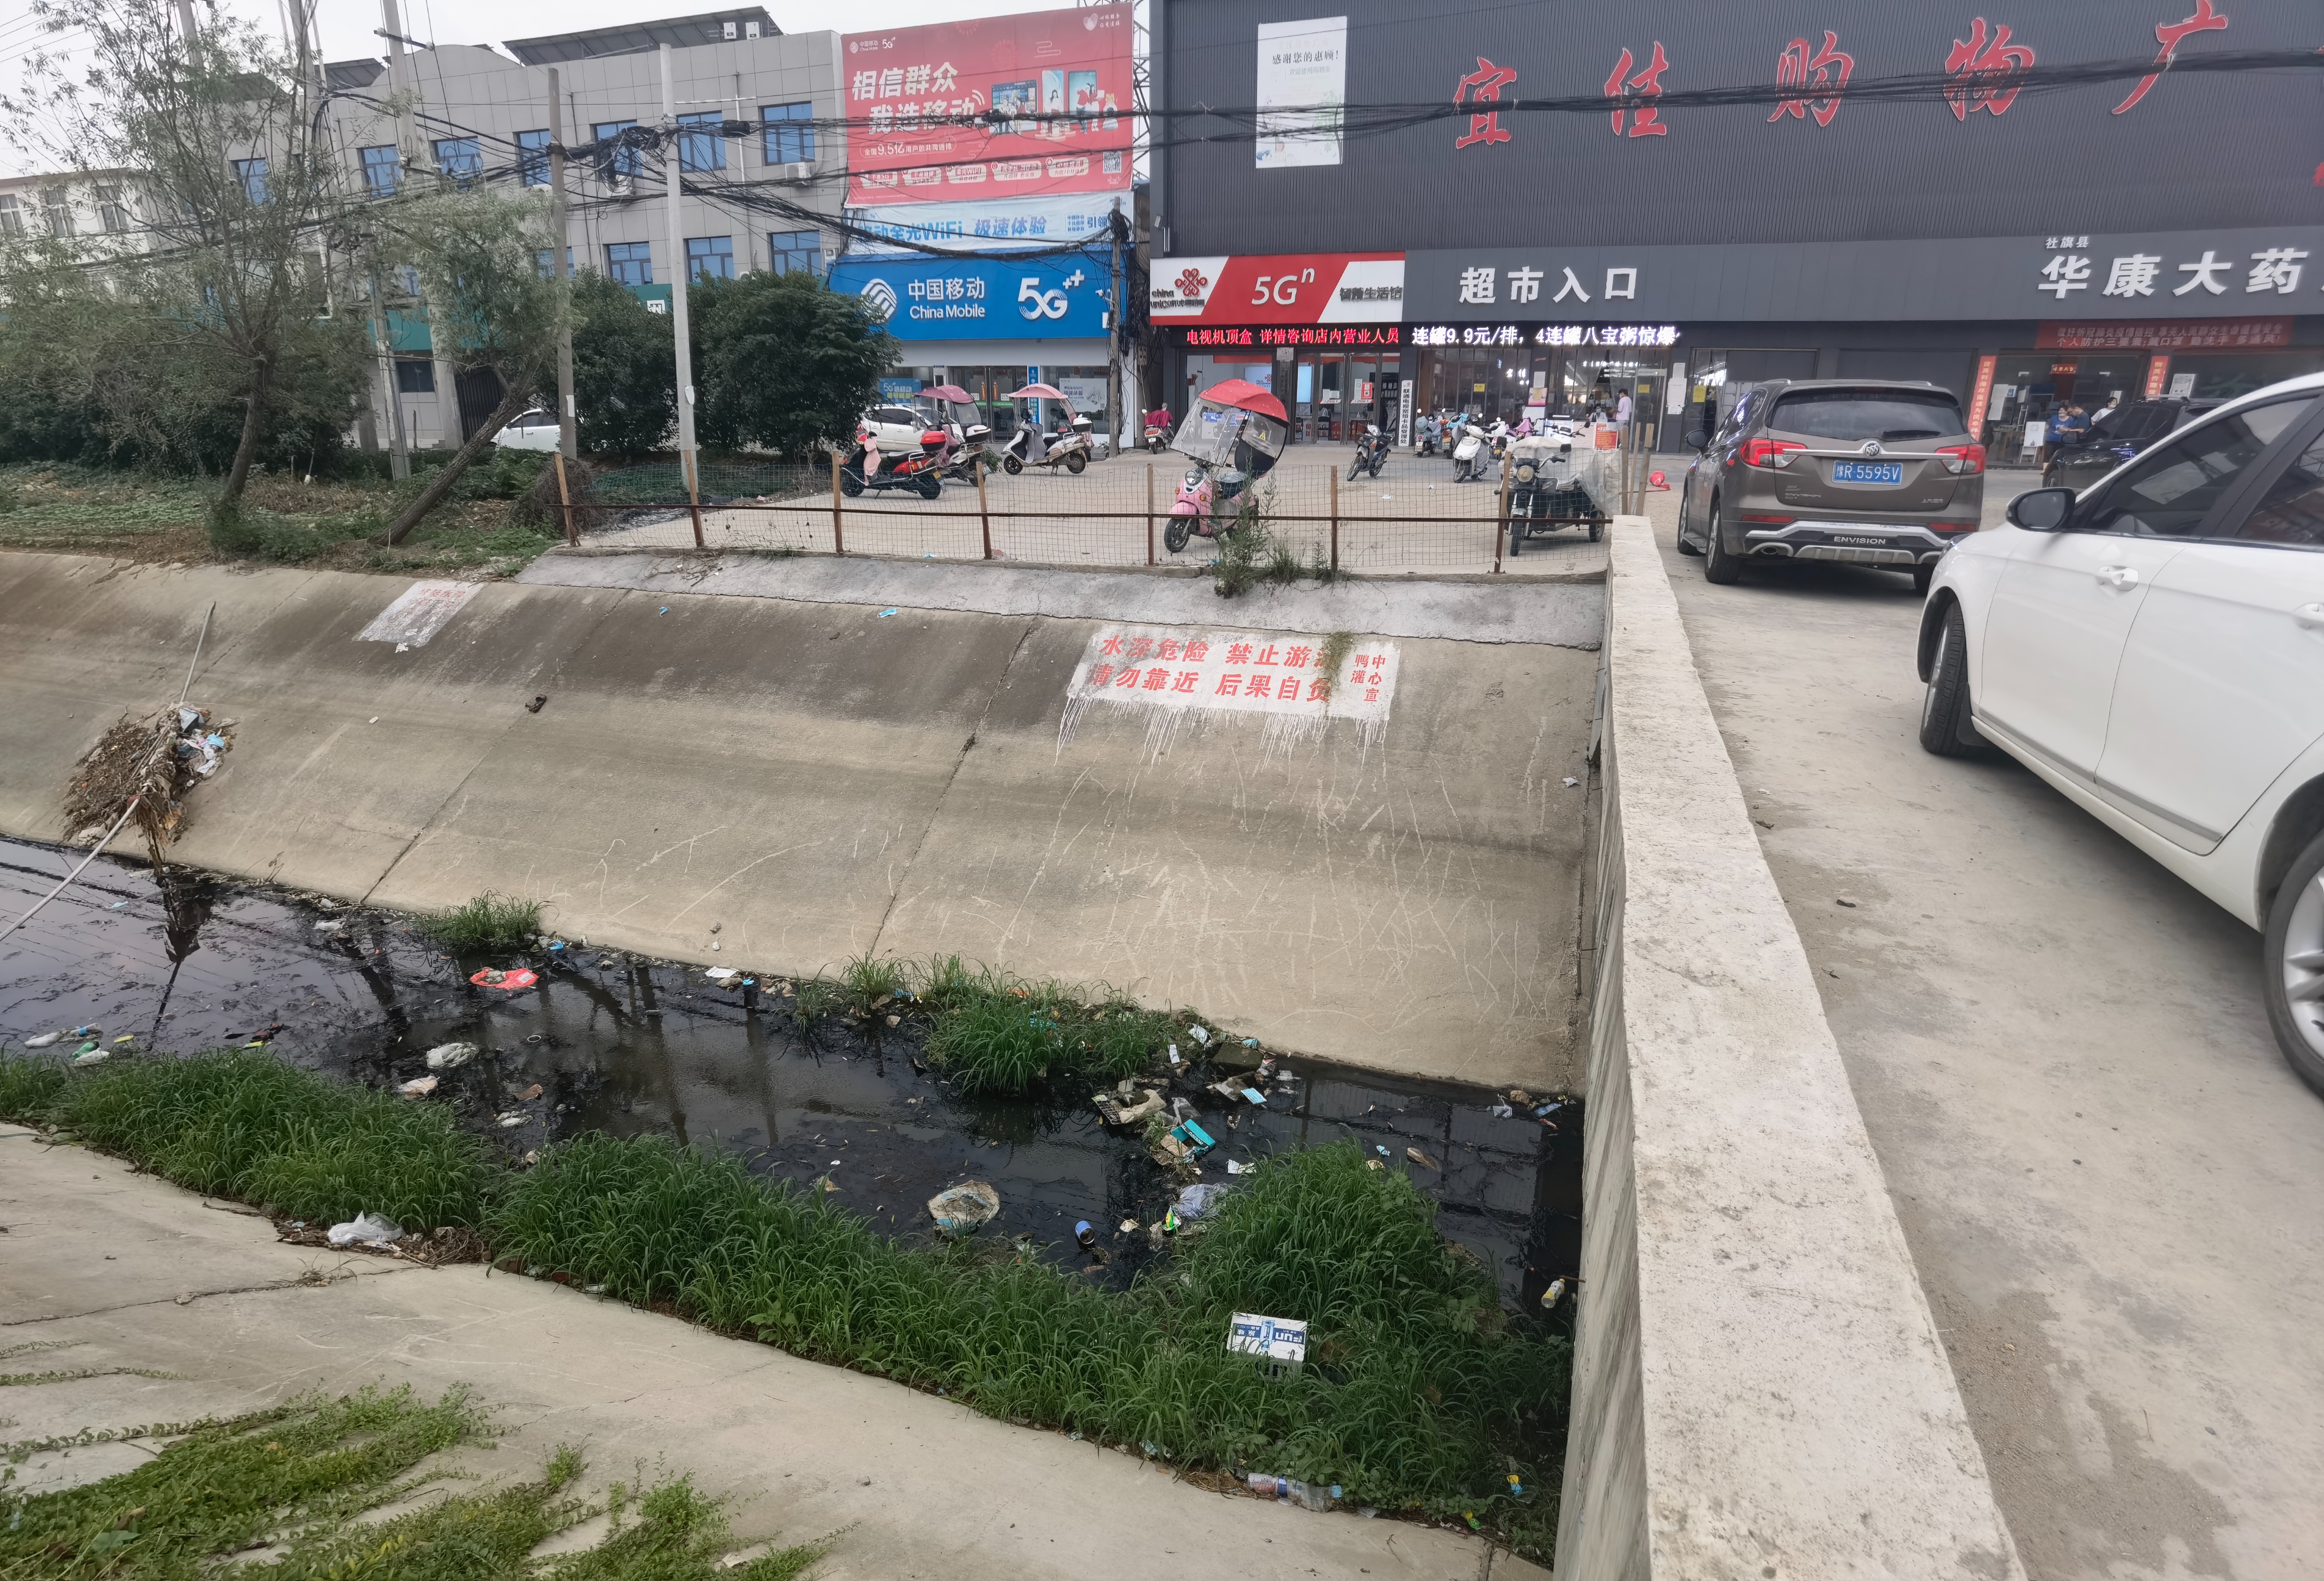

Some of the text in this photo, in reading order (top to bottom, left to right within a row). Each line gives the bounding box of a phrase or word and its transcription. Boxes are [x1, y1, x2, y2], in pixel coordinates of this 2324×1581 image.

[852, 62, 958, 101] 相信群众
[1454, 0, 2324, 149] 宜佳购物广
[974, 216, 1047, 237] 极速体验
[2046, 236, 2090, 249] 社旗县
[1459, 266, 1638, 304] 超市入口
[2037, 248, 2324, 299] 华康大药
[908, 277, 985, 301] 中国移动
[909, 304, 986, 320] China Mobile
[1187, 327, 1399, 345] 电视机顶盒 详情咨询店内营业人员
[1834, 536, 1886, 545] ENVISION
[1101, 634, 1210, 663] 水深危险
[1086, 663, 1332, 703] 请勿靠近 后果自负
